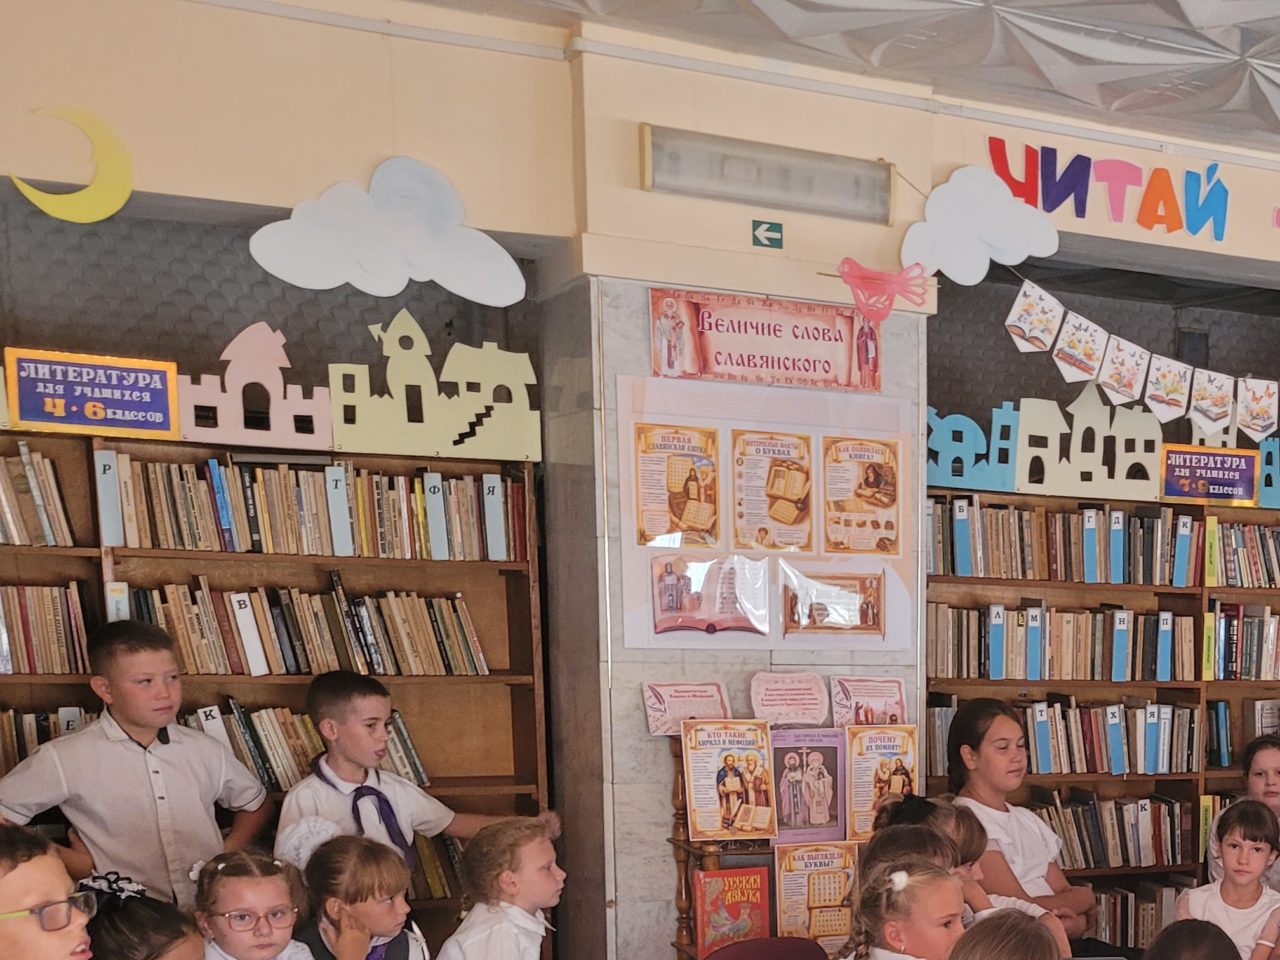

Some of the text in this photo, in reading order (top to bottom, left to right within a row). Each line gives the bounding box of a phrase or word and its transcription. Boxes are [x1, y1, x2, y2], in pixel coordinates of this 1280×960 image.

[988, 135, 1229, 242] ЧИТАЙ
[19, 362, 163, 389] ЛИТЕРАТУРА
[1167, 454, 1246, 469] ЛИТЕРАТУРА
[101, 463, 112, 475] Р
[429, 484, 440, 496] Ф
[486, 485, 496, 496] Я
[236, 600, 248, 610] В
[202, 710, 217, 722] К
